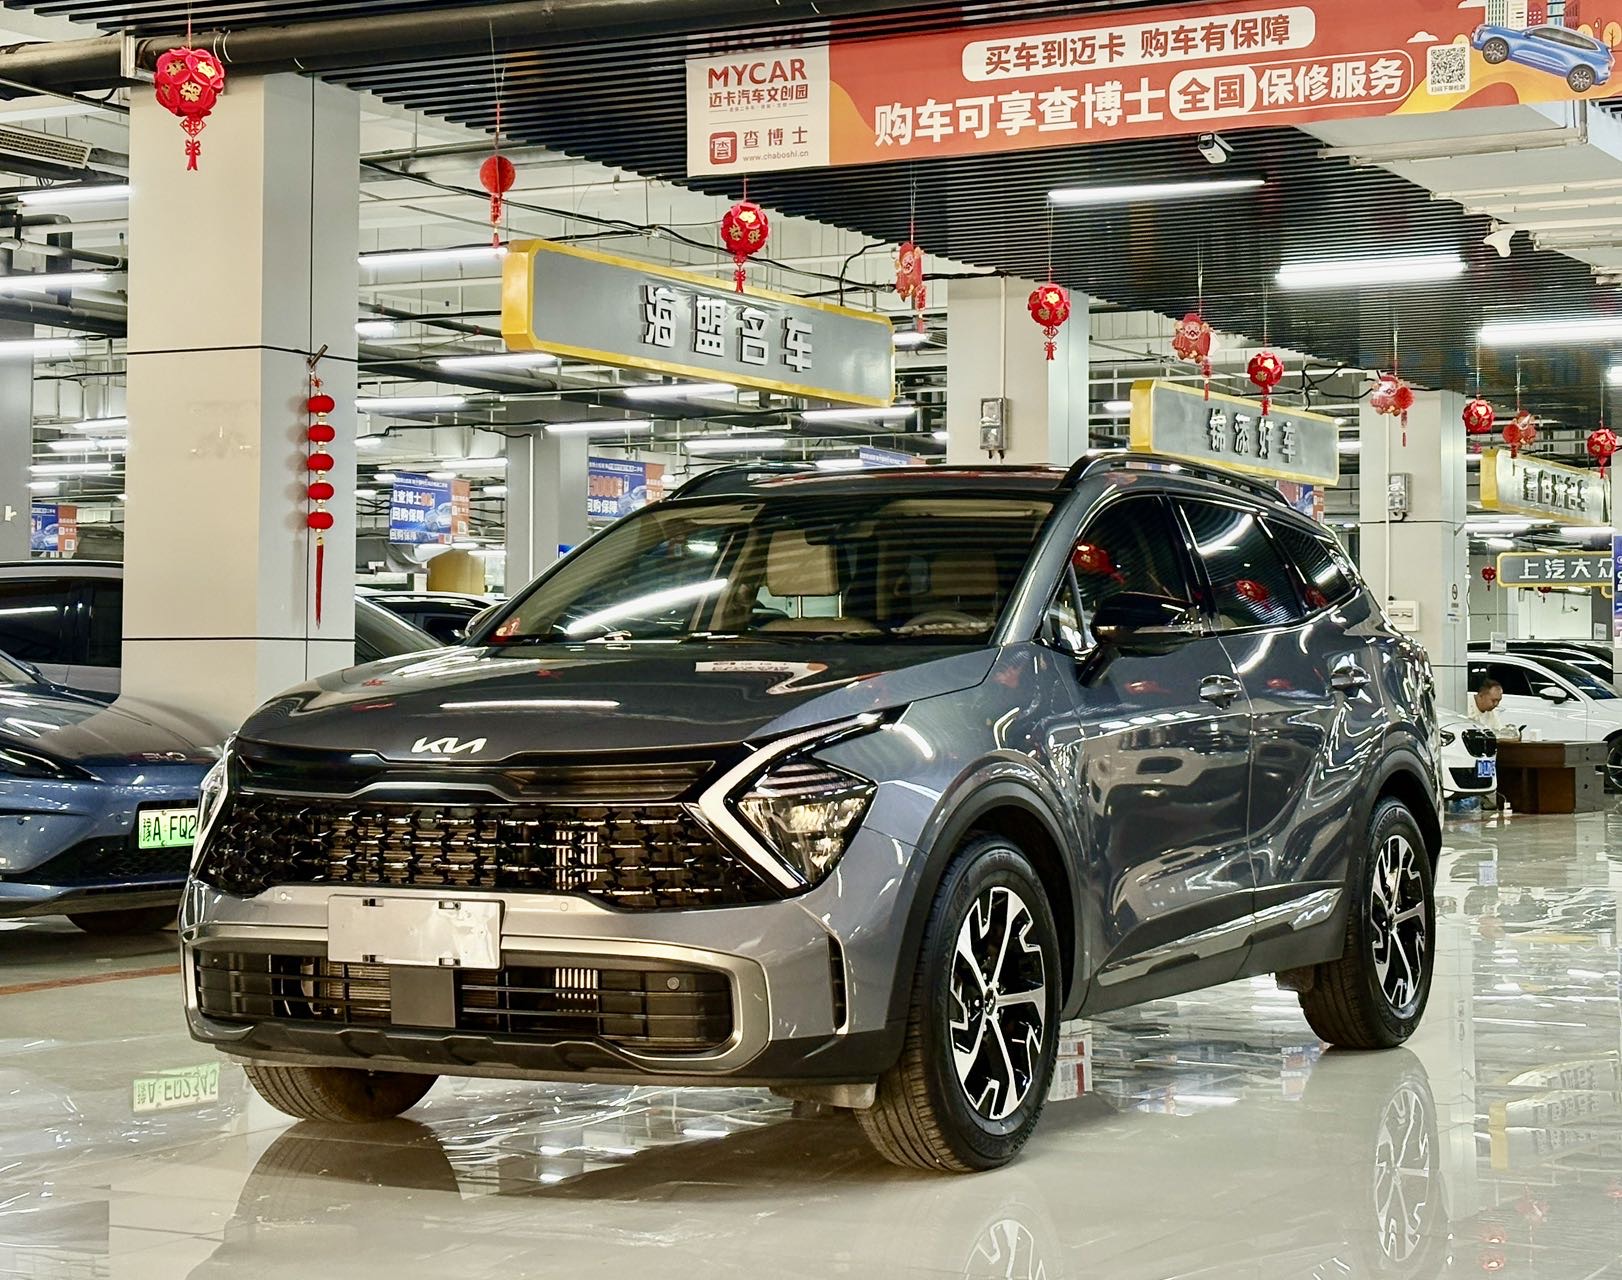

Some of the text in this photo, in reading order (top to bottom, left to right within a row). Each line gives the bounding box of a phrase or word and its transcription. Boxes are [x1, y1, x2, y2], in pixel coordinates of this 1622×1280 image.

[985, 14, 1291, 75] 买车到迈卡 购车有保障
[708, 58, 807, 89] MYCAR
[709, 84, 808, 108] 迈卡汽车文创园
[875, 58, 1404, 147] 购车可享查博士全国保修服务
[743, 126, 808, 149] 查博士
[743, 149, 809, 162] www.chaboshi.cn
[1519, 557, 1612, 580] 上汽大众
